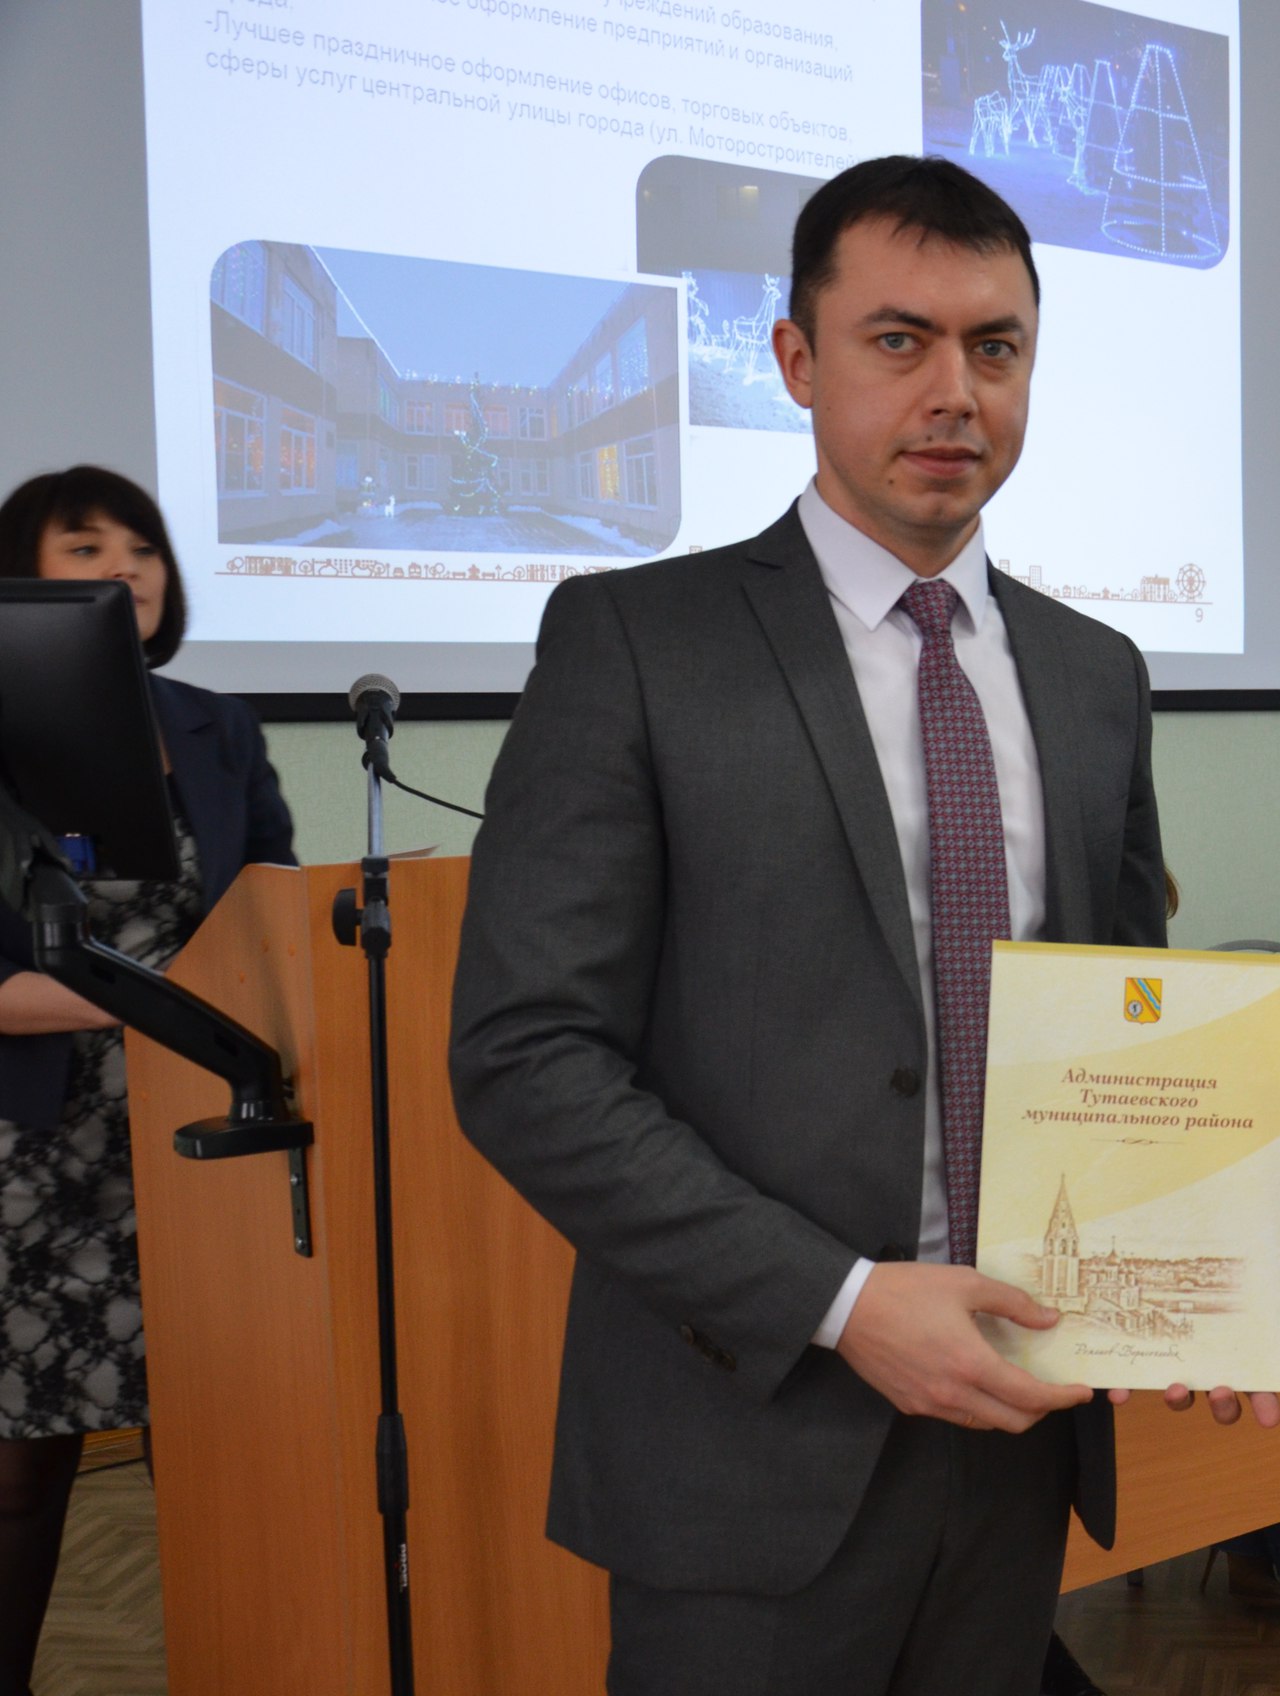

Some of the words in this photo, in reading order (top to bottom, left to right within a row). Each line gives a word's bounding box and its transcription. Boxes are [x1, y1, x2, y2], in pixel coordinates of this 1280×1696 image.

[720, 10, 839, 52] образования,
[604, 20, 726, 58] предприятий
[729, 47, 739, 60] и
[745, 47, 854, 84] организаций
[205, 10, 305, 46] -Лучшее
[313, 33, 456, 73] праздничное
[461, 57, 593, 96] оформление
[598, 81, 677, 113] офисов,
[681, 97, 765, 127] торговых
[206, 48, 288, 80] сферы
[296, 65, 357, 93] услуг
[362, 76, 501, 113] центральной
[507, 100, 571, 126] улицы
[578, 112, 644, 137] города
[650, 120, 684, 146] (ул.
[1194, 608, 1204, 624] 9
[1062, 1068, 1218, 1091] Администрация
[1079, 1088, 1198, 1108] Тутаевского
[1022, 1108, 1180, 1126] муниципального
[1185, 1113, 1253, 1131] района
